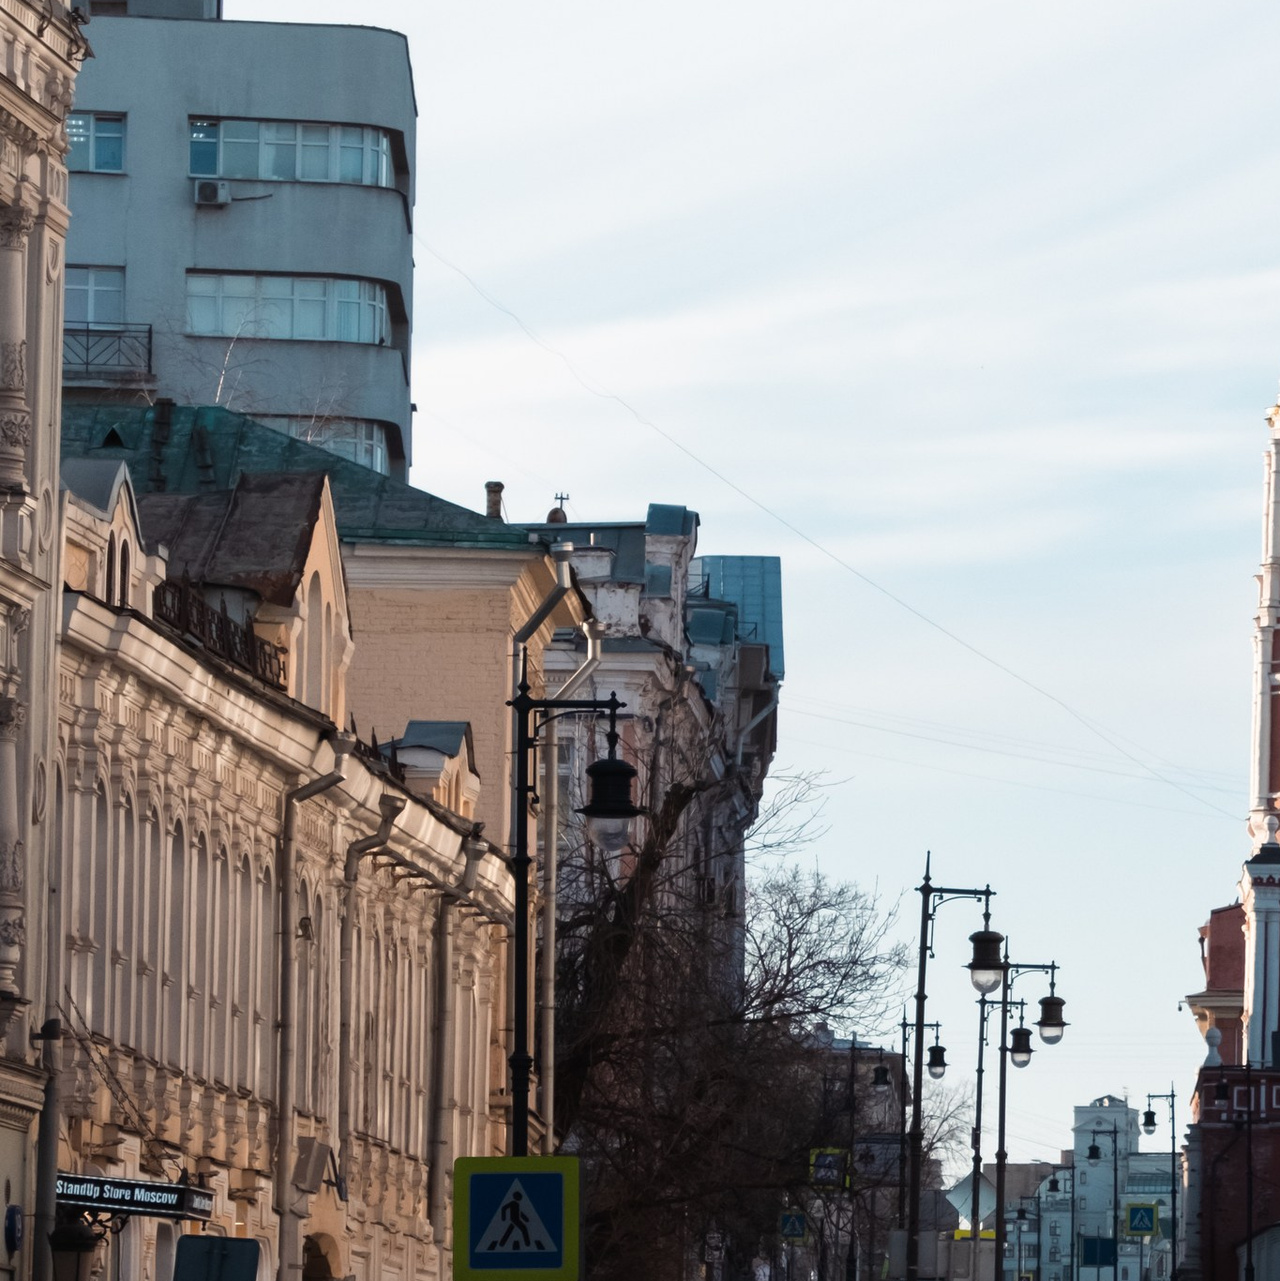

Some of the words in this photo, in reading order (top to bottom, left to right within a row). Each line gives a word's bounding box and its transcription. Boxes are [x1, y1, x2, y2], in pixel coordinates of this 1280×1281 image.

[56, 1180, 100, 1199] StandUp
[103, 1184, 131, 1201] Store
[134, 1187, 178, 1205] Moscow
